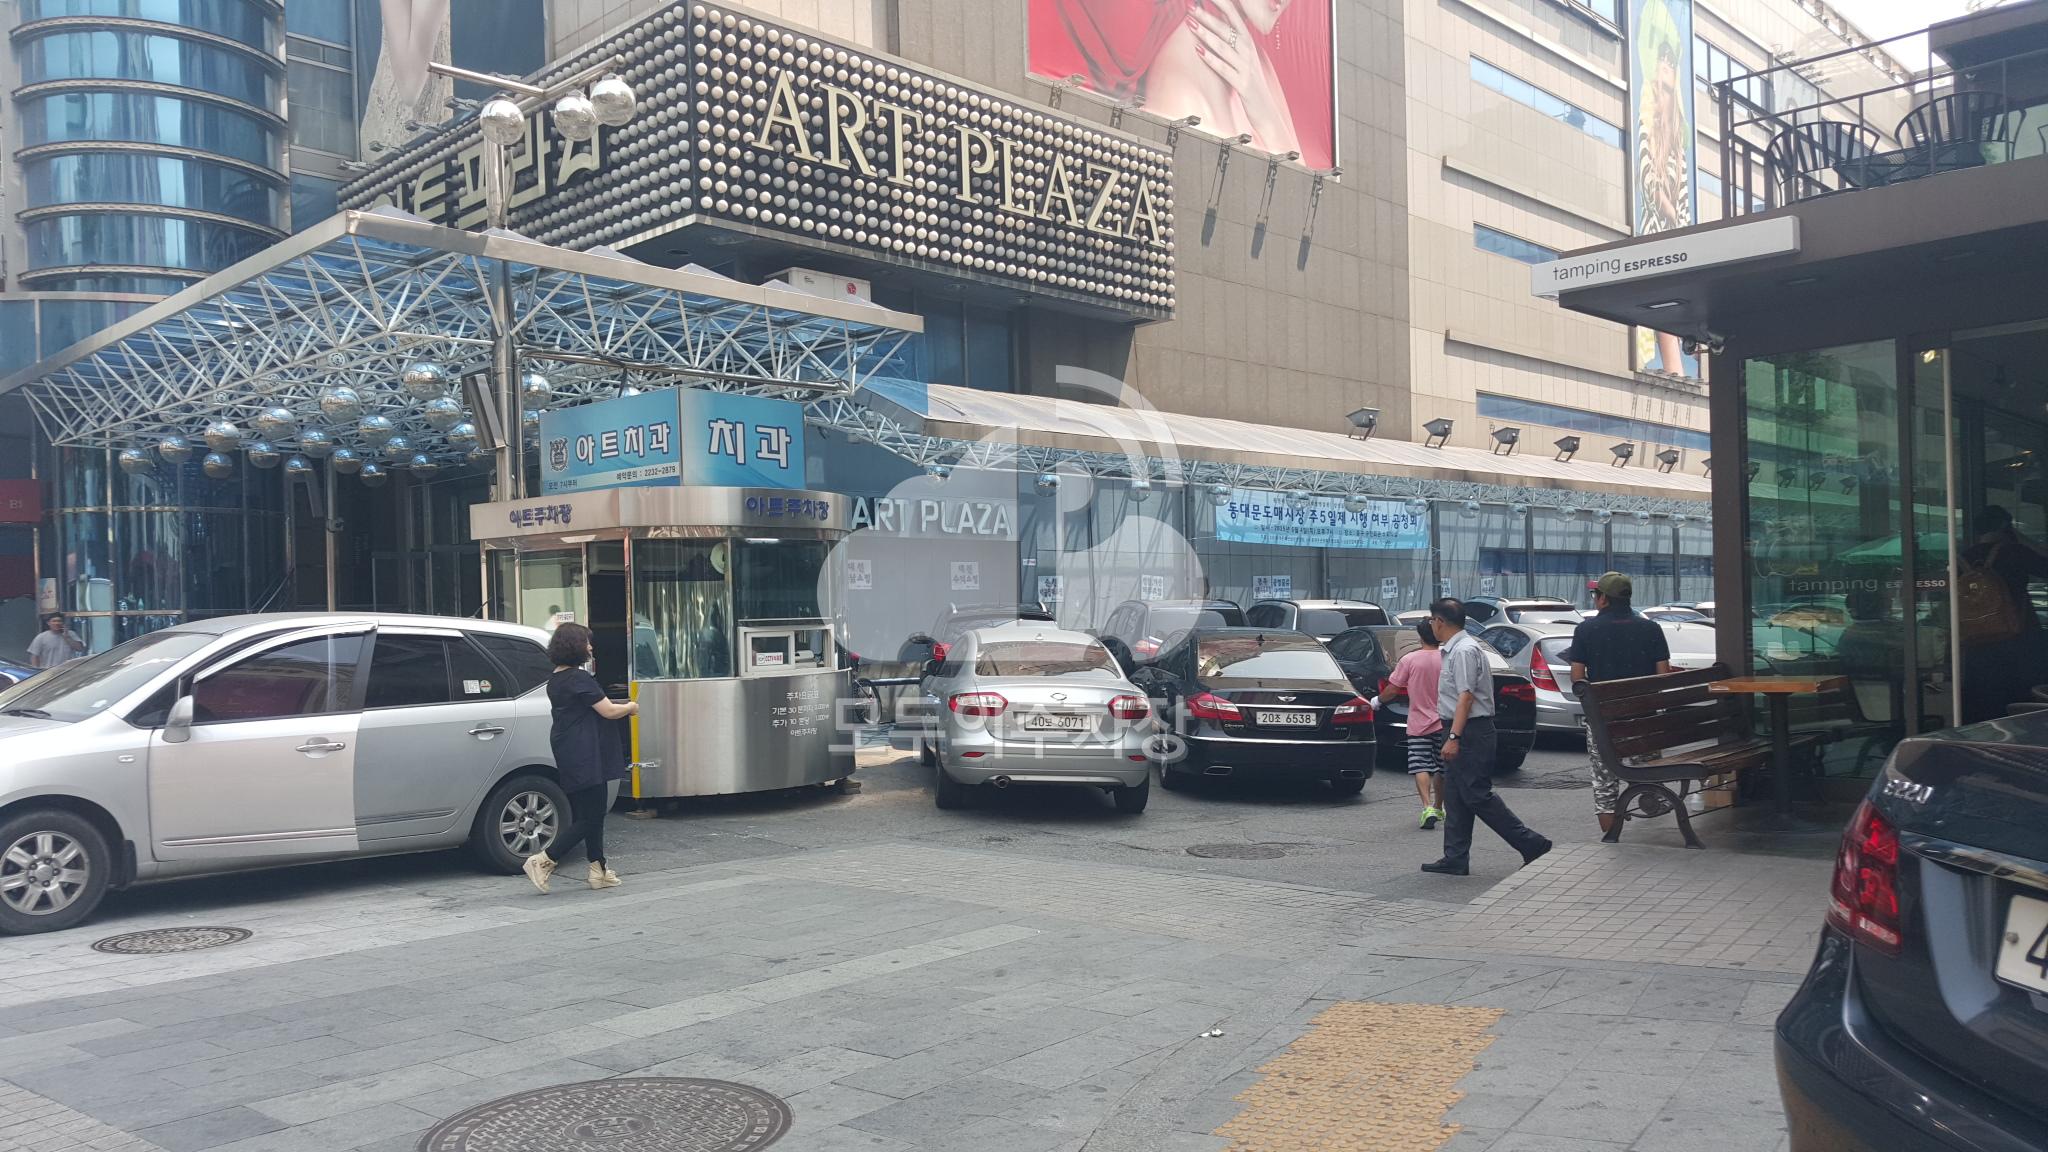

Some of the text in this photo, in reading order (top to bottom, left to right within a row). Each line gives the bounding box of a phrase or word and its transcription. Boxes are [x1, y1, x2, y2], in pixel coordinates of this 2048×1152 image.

[751, 69, 1166, 249] ART PLAZA
[1553, 252, 1688, 281] tamping ESPRESSO
[575, 420, 671, 466] 아트치과
[708, 417, 792, 470] 치과
[644, 465, 676, 477] 2232-2879
[509, 503, 573, 529] 아트주차장
[745, 496, 829, 521] 아트주차장
[851, 496, 1013, 536] ART PLAZA
[1227, 502, 1305, 525] 동대문도매시장
[1308, 509, 1346, 527] 주5일제
[1350, 511, 1368, 529] 시행
[1371, 512, 1389, 527] 여부
[1392, 513, 1418, 529] 공청회
[1789, 577, 1878, 593] tamping
[1286, 713, 1311, 724] 6538
